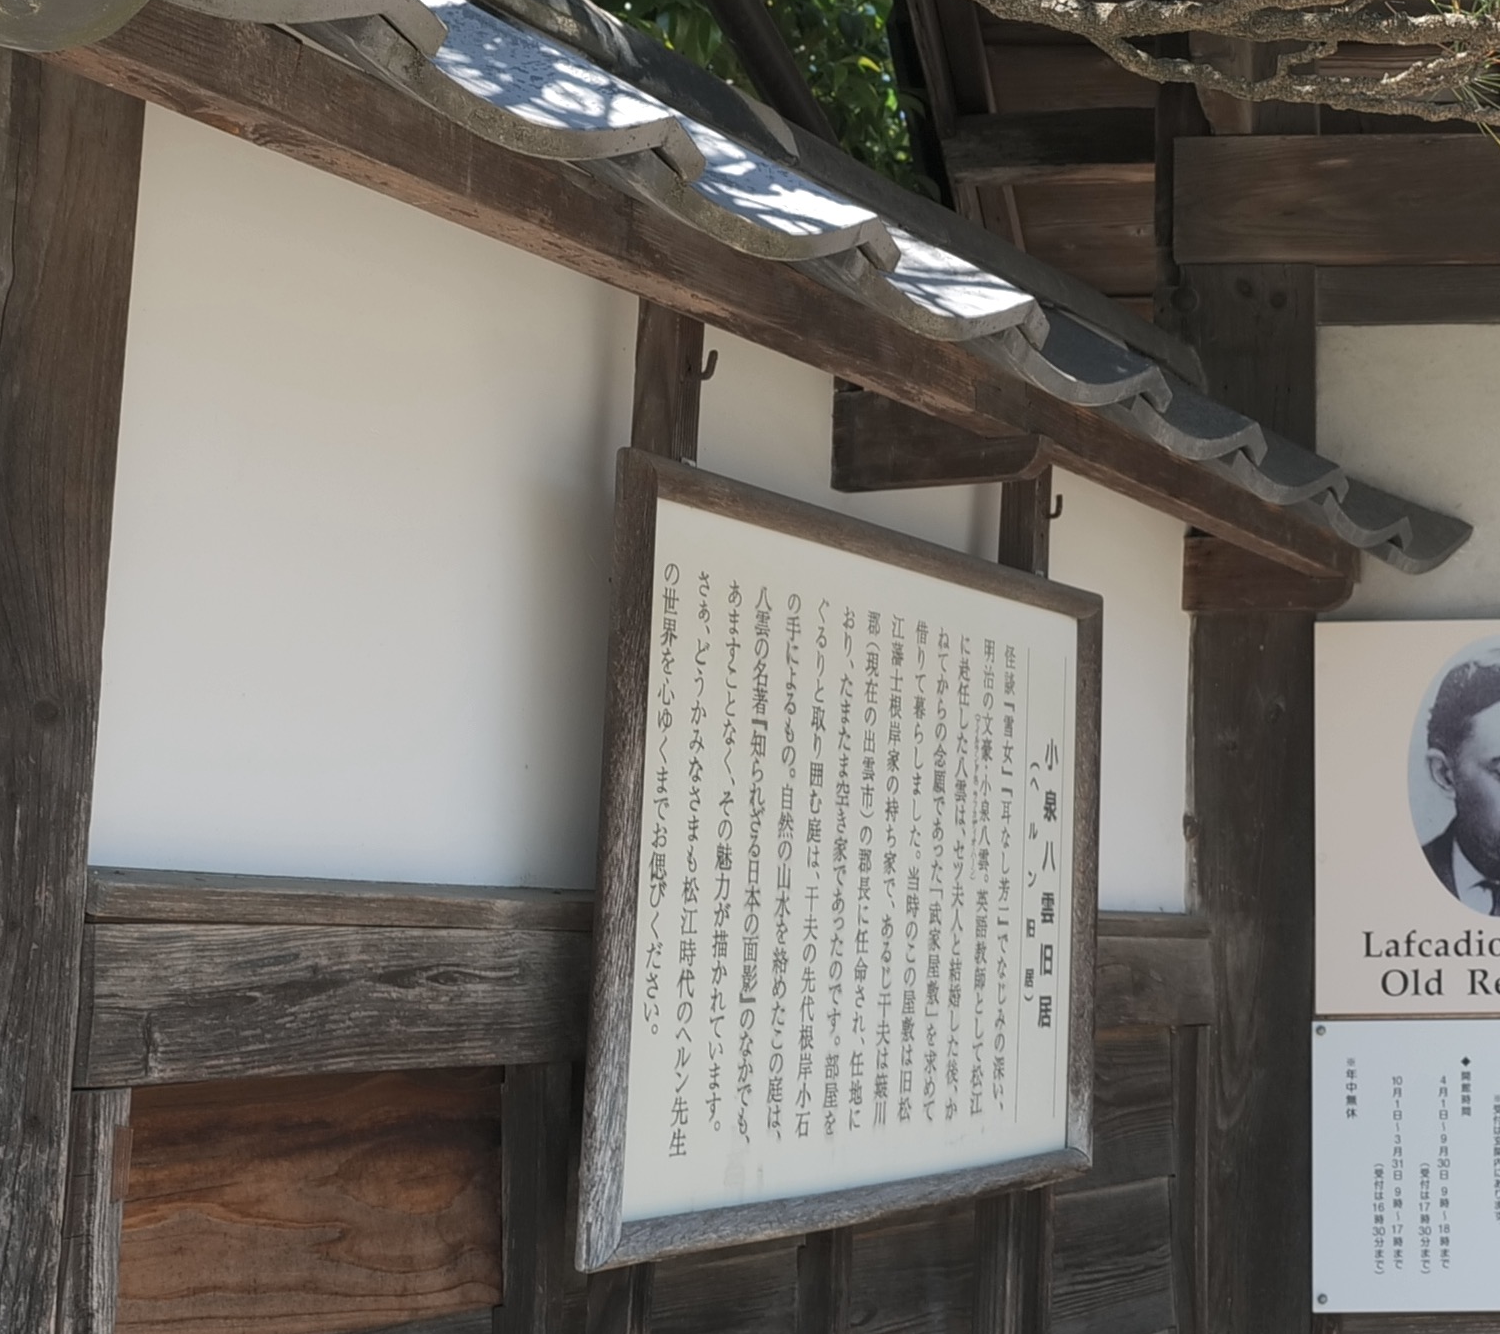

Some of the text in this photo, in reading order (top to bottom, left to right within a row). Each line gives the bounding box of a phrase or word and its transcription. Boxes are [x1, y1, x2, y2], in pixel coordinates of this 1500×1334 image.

[643, 562, 679, 1035] の世界を心ゆくまでお偲びください。
[705, 579, 742, 1131] あますことなく、その魅力が描かれています。
[822, 605, 855, 1135] おり、たまたま空き家であったのです。部屋を
[897, 620, 928, 1122] 借りて暮らしました。当時のこの屋敷は旧松
[1023, 761, 1040, 1001] （ヘルン旧居）
[1037, 738, 1058, 1028] 小泉八雲旧居
[1381, 969, 1443, 996] Old
